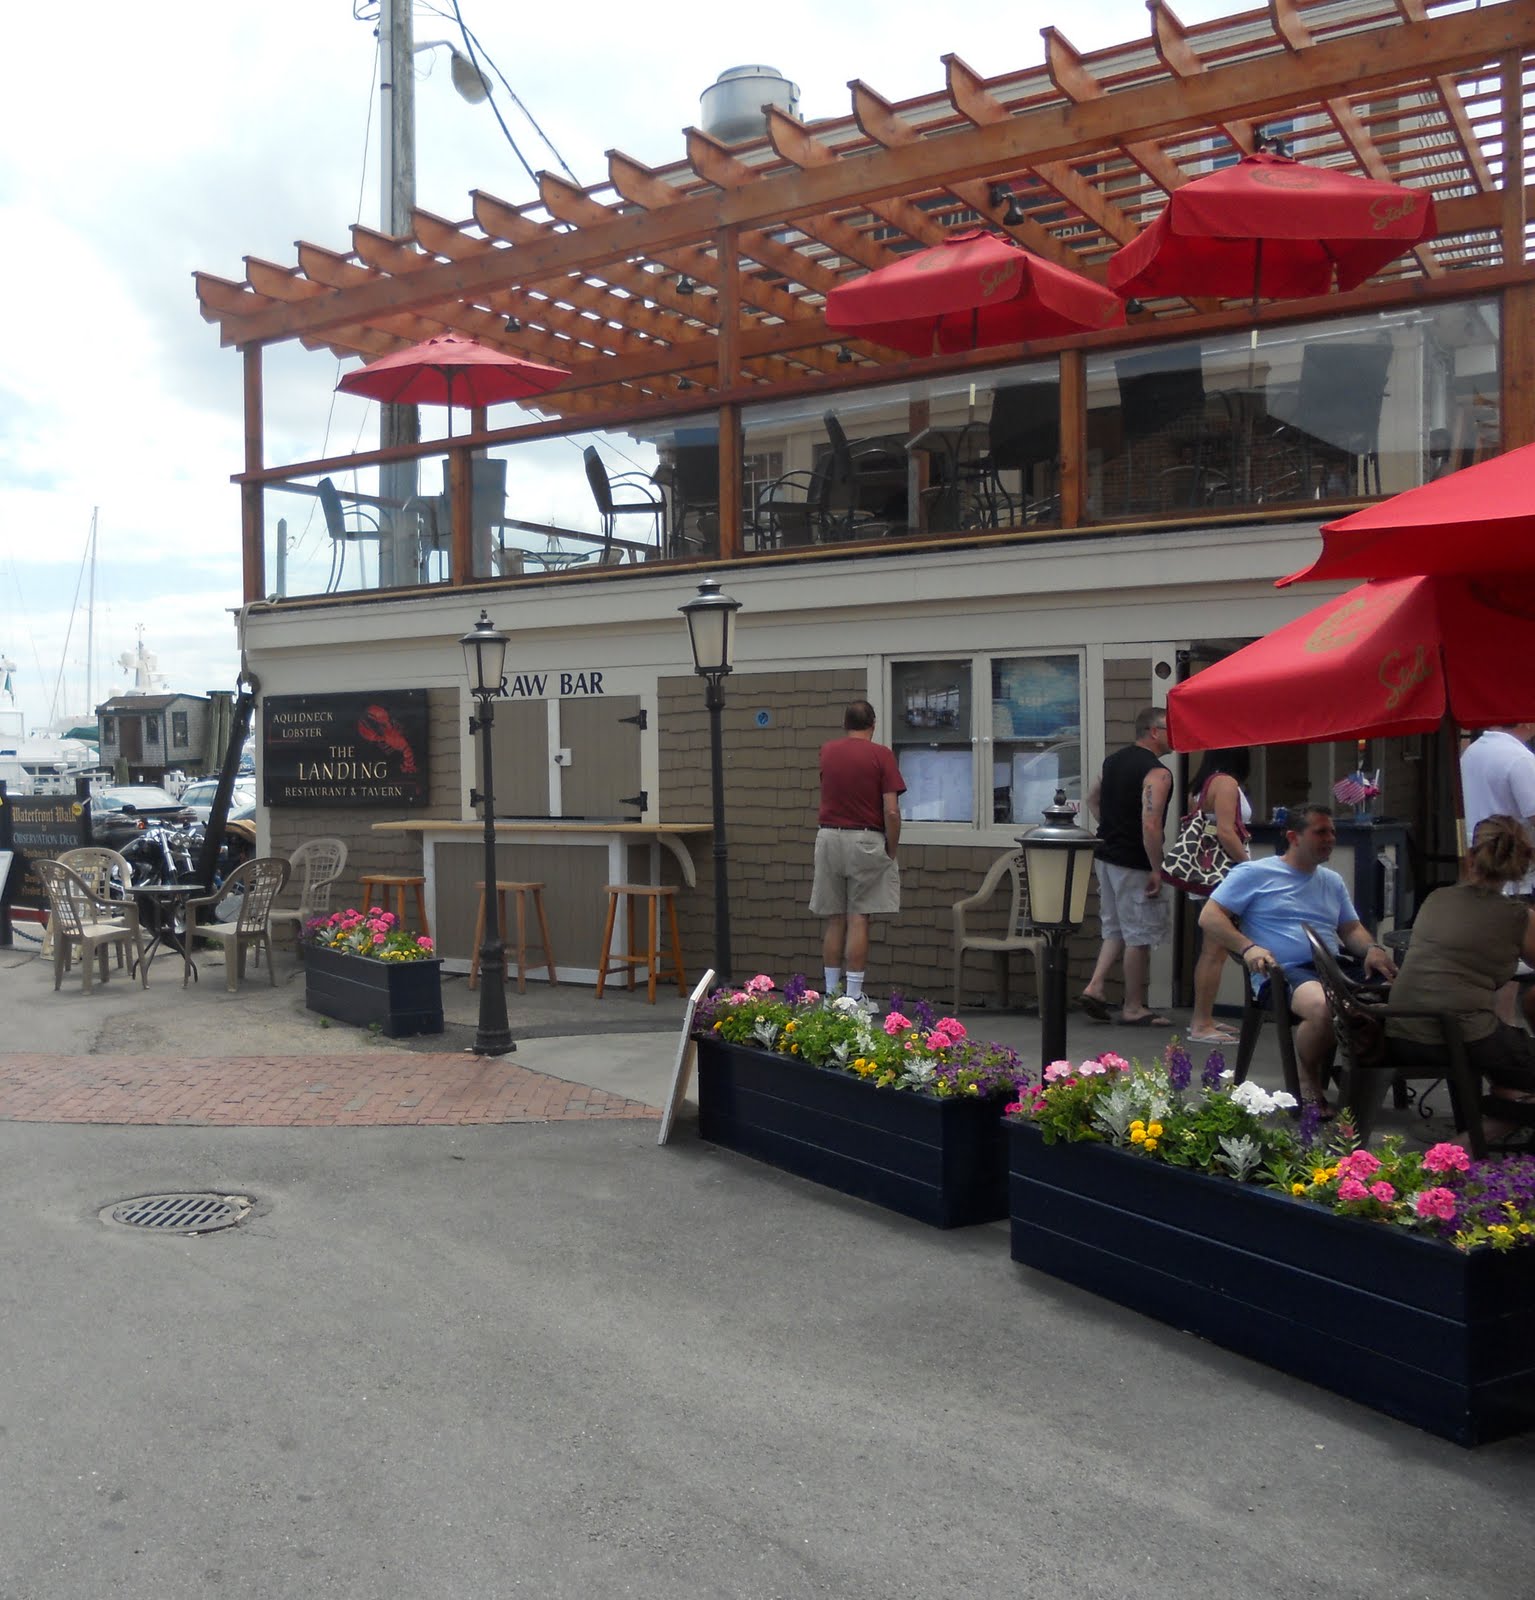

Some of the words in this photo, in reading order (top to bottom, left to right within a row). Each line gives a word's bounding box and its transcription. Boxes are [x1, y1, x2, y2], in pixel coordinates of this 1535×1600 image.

[499, 674, 549, 698] RAW
[560, 672, 605, 696] BAR
[273, 711, 334, 724] AQUIDNECK
[282, 727, 322, 739] LOBSTER
[329, 746, 356, 758] THE
[299, 761, 388, 781] LANDING
[285, 786, 347, 797] RESTAURANT
[350, 787, 357, 797] &
[361, 786, 403, 797] TAVERN
